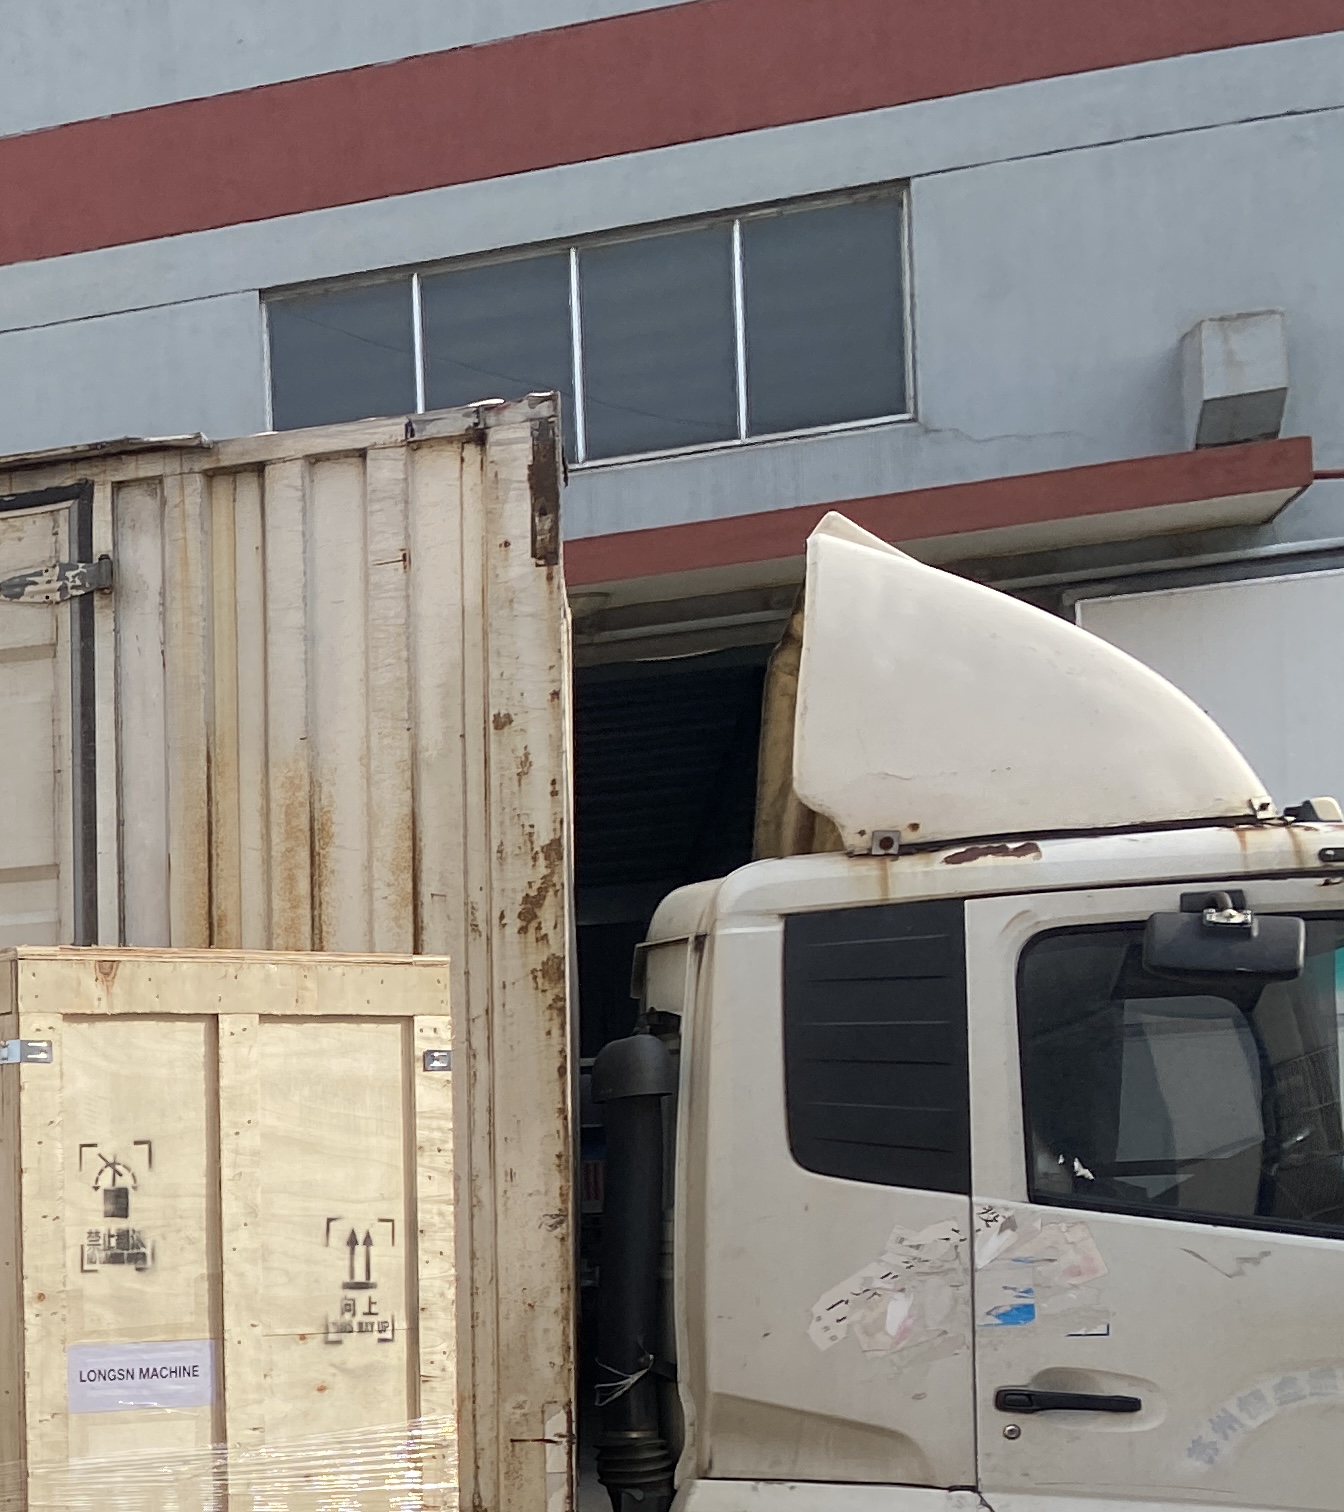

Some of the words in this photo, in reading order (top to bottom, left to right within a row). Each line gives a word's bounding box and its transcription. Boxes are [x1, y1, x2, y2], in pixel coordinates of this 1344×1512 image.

[341, 1294, 379, 1318] 向上
[79, 1367, 135, 1383] LONGSN
[139, 1364, 200, 1380] MACHINE
